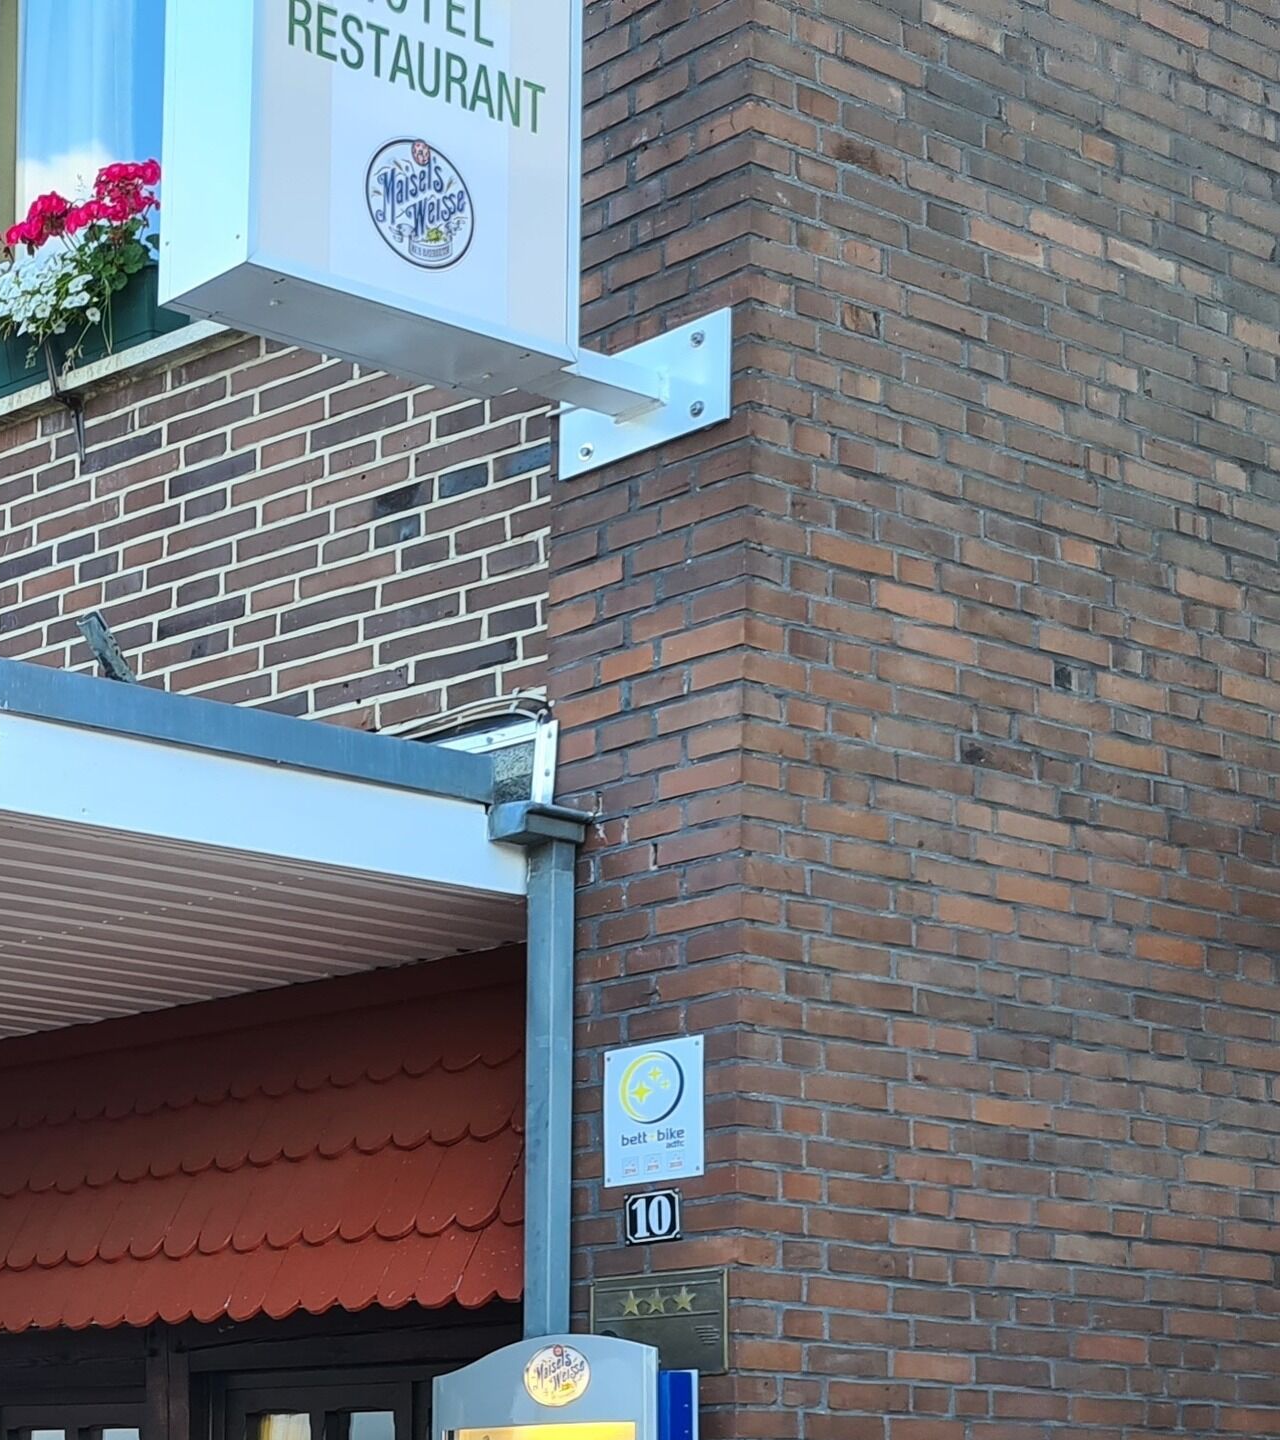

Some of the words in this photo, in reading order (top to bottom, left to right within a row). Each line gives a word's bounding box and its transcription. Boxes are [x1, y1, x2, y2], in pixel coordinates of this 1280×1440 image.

[288, 0, 546, 134] RESTAURANT
[375, 155, 444, 225] Maisel's
[405, 190, 466, 238] Weisse
[630, 1194, 672, 1238] 10
